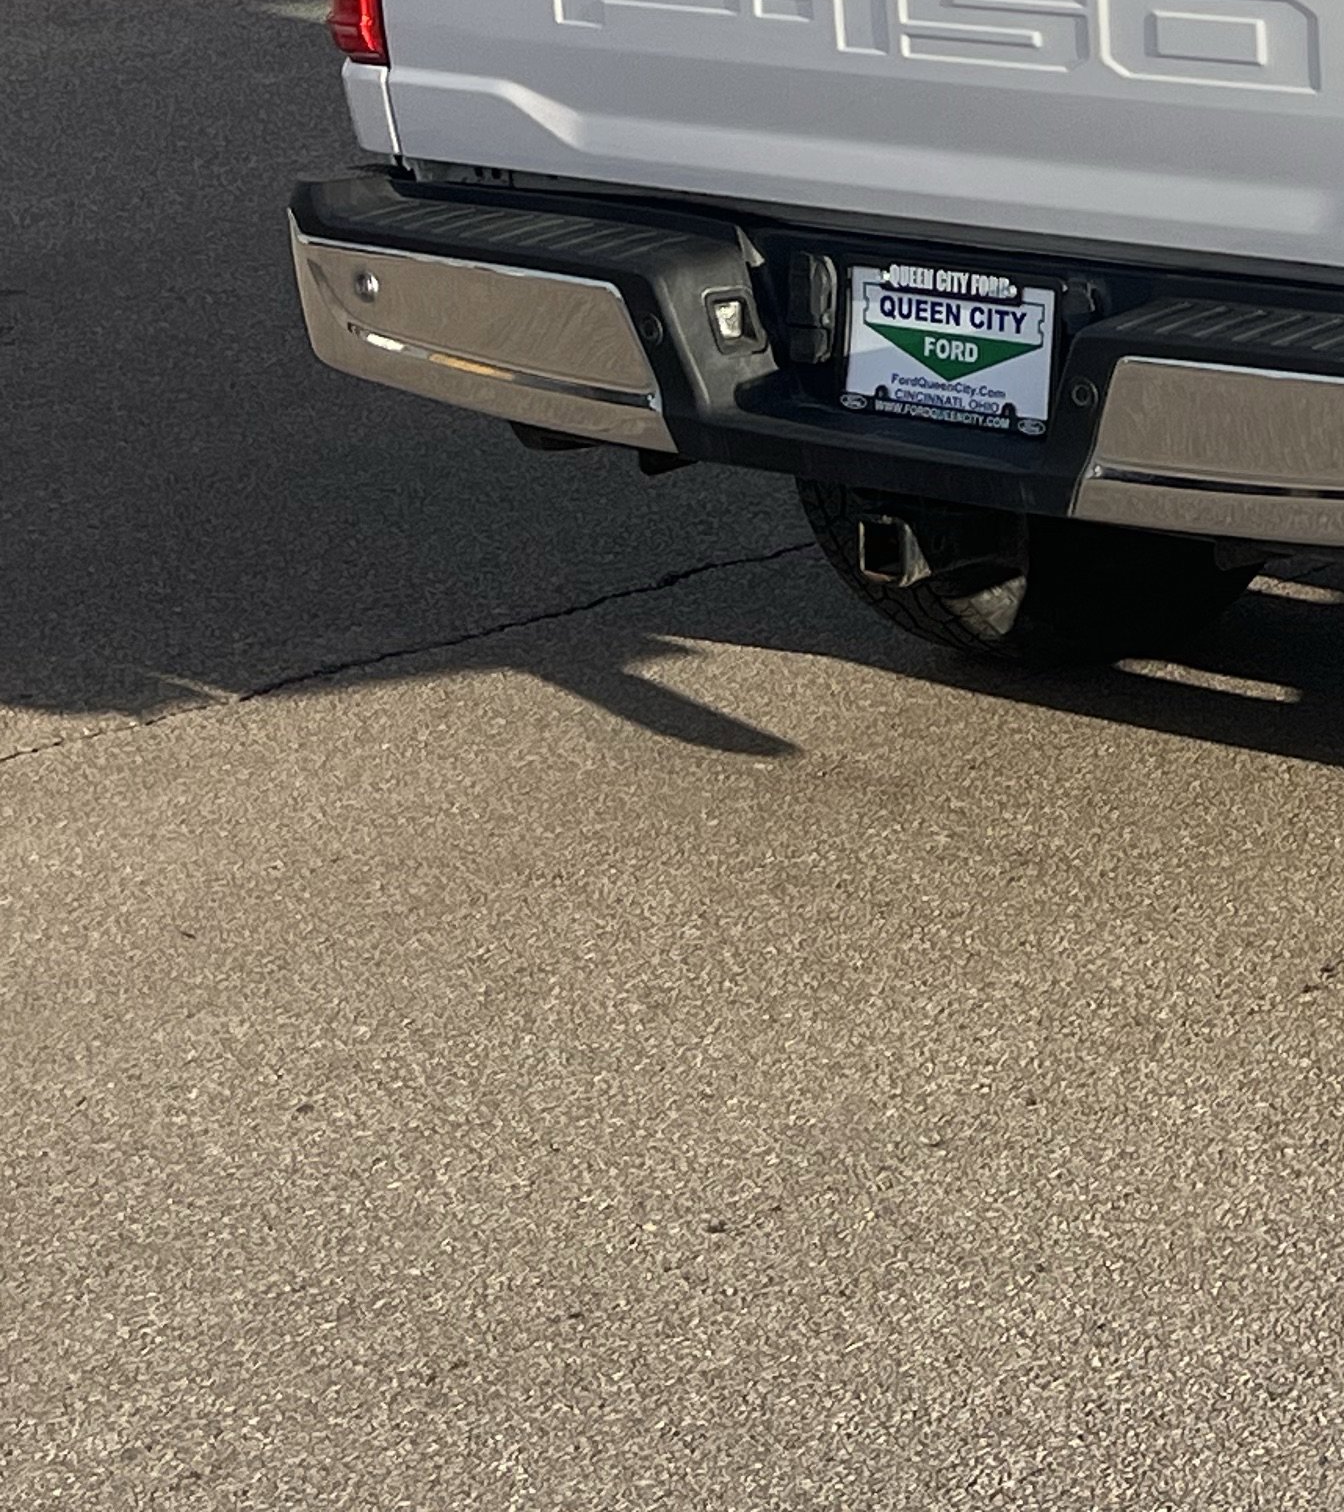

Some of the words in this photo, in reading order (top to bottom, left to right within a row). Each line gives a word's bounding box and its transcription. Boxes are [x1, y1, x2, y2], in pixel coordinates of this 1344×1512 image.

[889, 264, 934, 290] QUEEN
[936, 269, 970, 295] CITY
[970, 273, 1010, 299] FORD
[880, 295, 961, 327] QUEEN
[969, 306, 1028, 335] CITY
[923, 336, 979, 364] FORD
[968, 398, 1000, 414] OHIO
